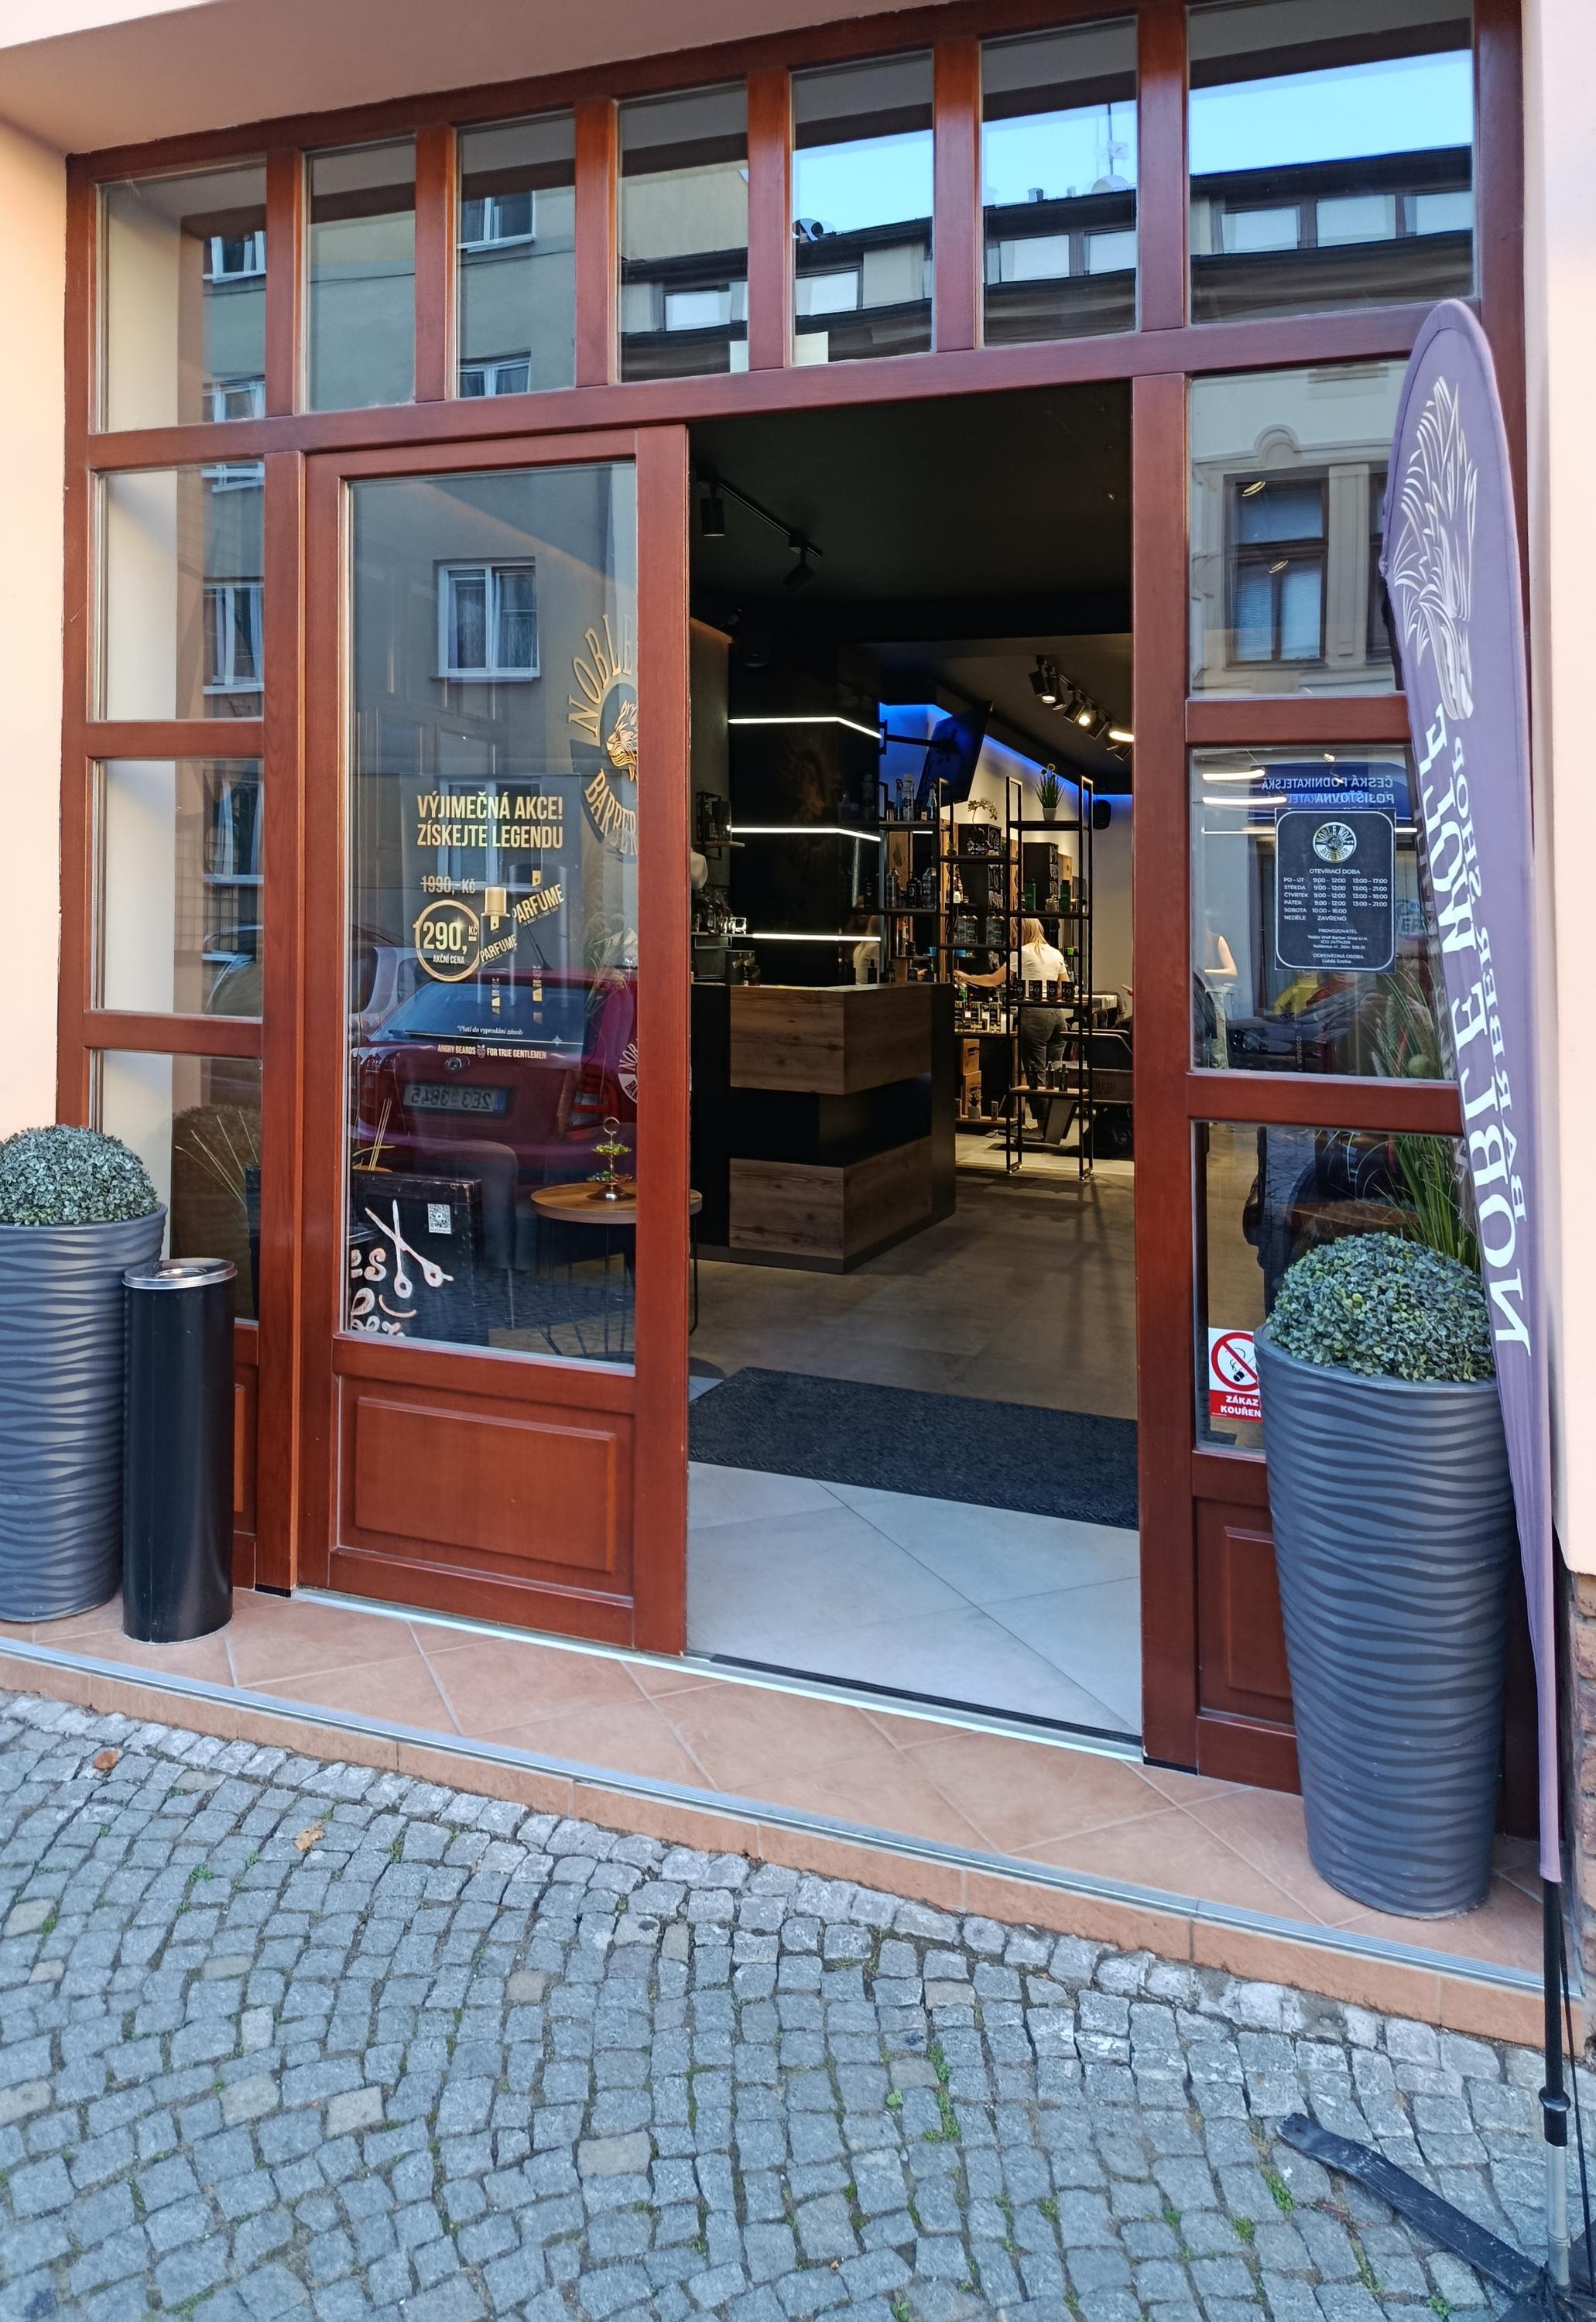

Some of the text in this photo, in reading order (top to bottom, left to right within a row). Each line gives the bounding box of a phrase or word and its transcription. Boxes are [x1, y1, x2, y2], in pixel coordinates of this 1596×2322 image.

[568, 613, 632, 738] NOBLE
[417, 790, 563, 820] VÝJIMEČNÁ AKCE!
[417, 820, 563, 848] ZÍSKEJTE LEGENDU
[433, 953, 465, 964] AKČNÍ CENA
[480, 933, 518, 963] PARFUME
[437, 1044, 546, 1060] ANGRY BEARDS FOR TRUE GENTLEMEN
[1220, 1405, 1262, 1418] KOUŘEN
[1225, 1394, 1259, 1407] ZÁKAZ
